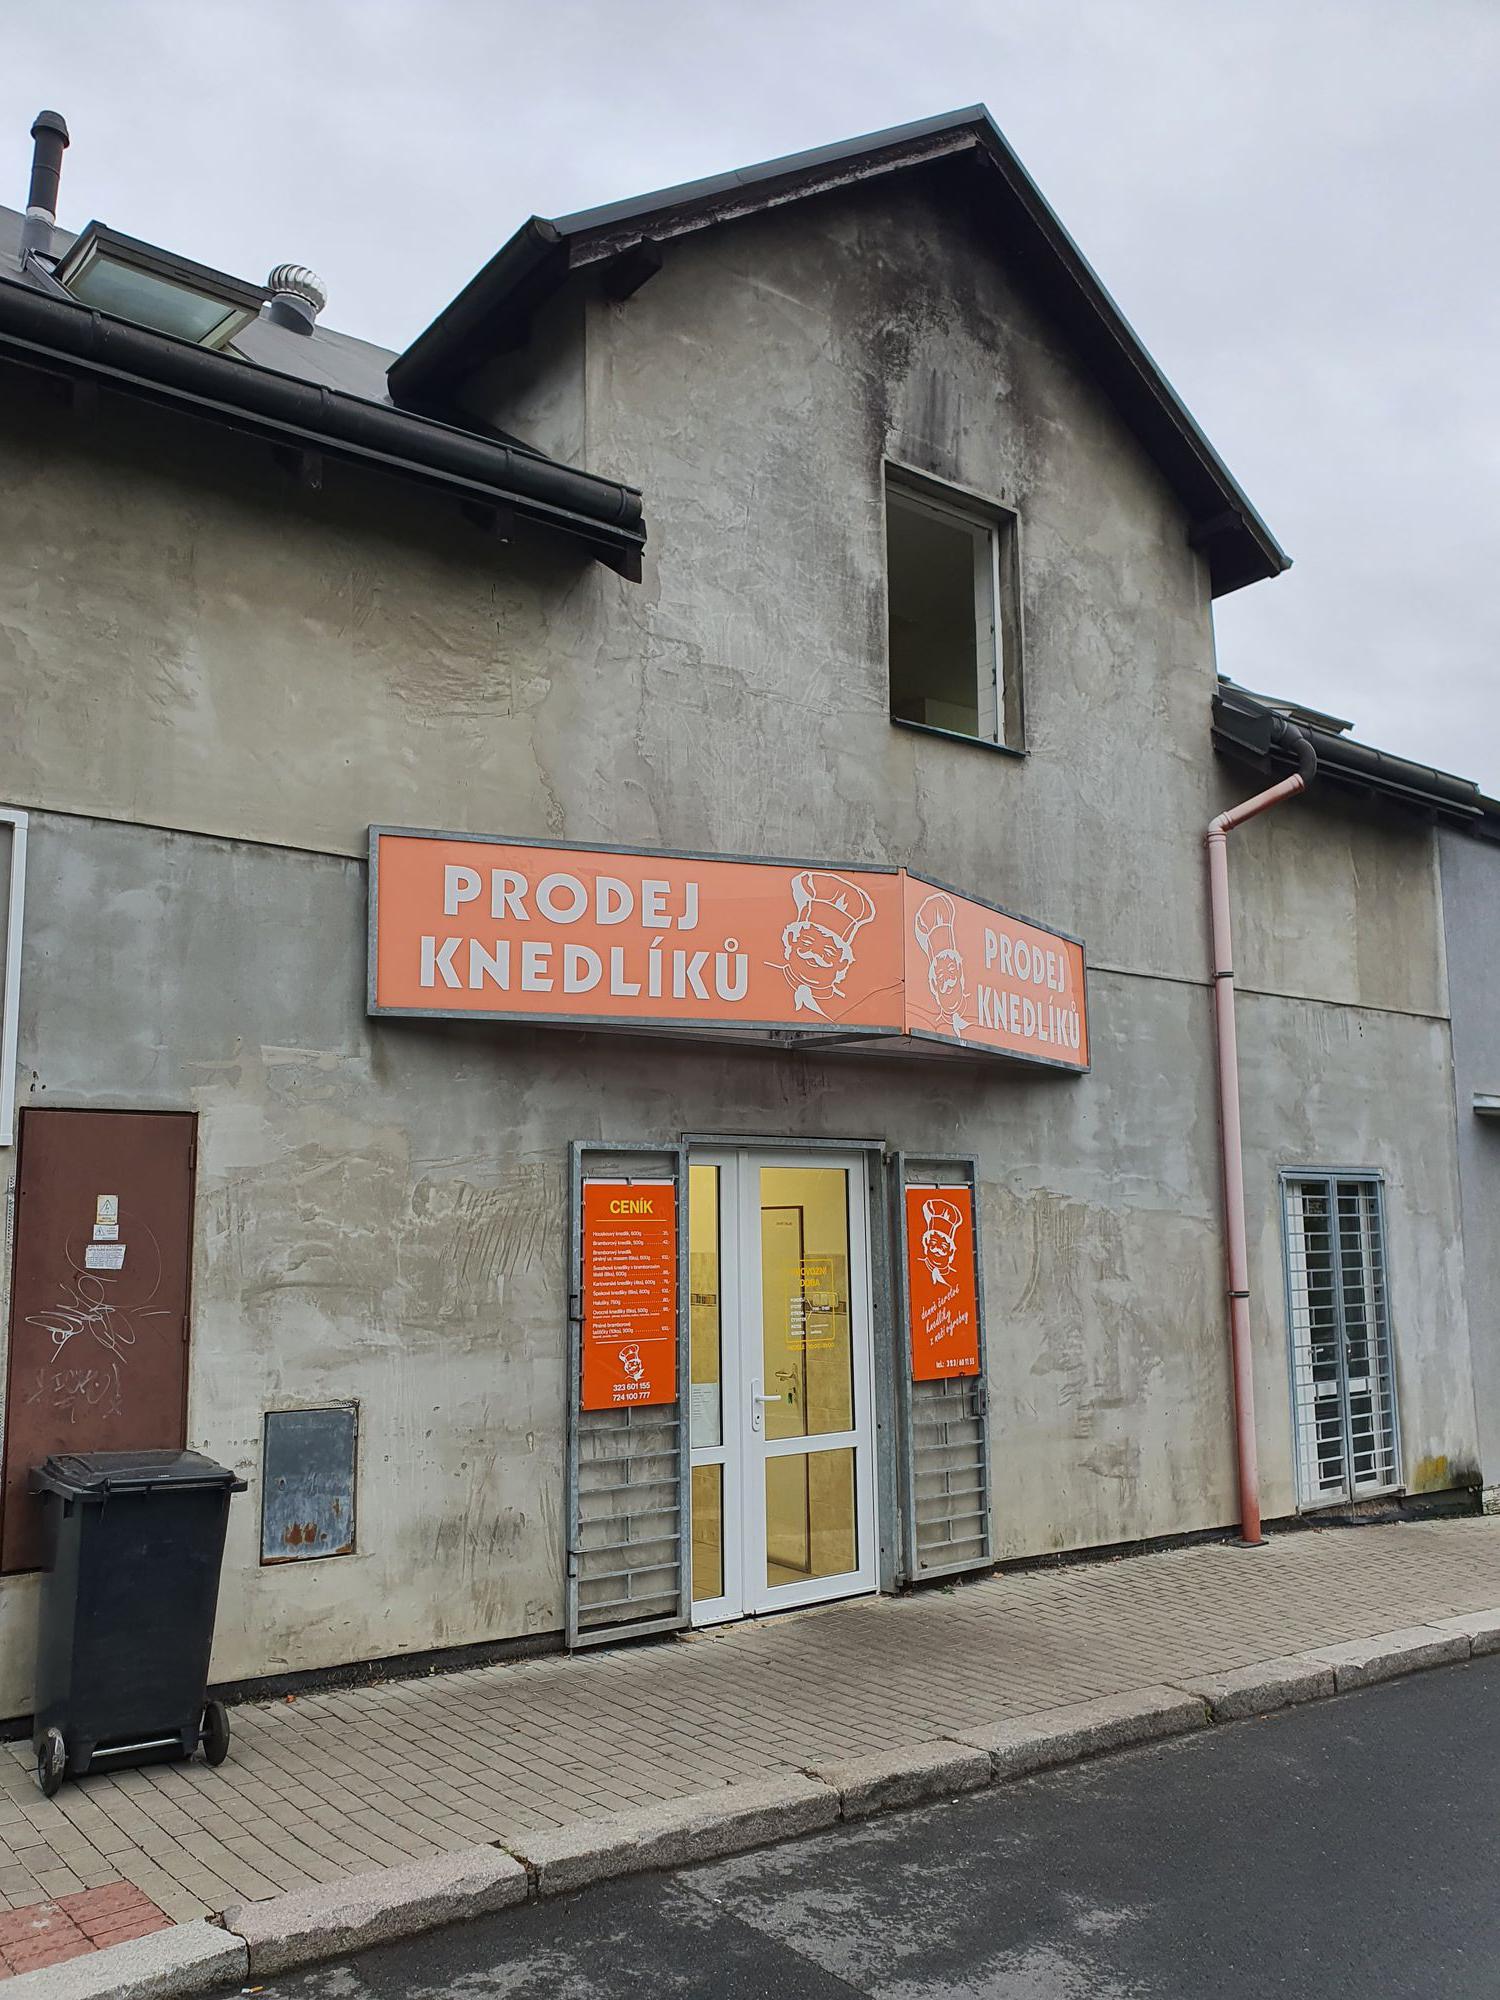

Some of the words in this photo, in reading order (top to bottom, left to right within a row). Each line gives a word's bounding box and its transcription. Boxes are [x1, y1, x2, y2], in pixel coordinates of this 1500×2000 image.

[444, 864, 699, 930] PRODEJ
[420, 935, 748, 1001] KNEDLÍKŮ
[984, 928, 1065, 993] PRODEJ
[977, 984, 1081, 1049] KNEDLÍKŮ
[609, 1197, 653, 1214] CENÍK
[613, 1384, 626, 1392] 323
[626, 1392, 638, 1400] 100
[639, 1391, 651, 1399] 777
